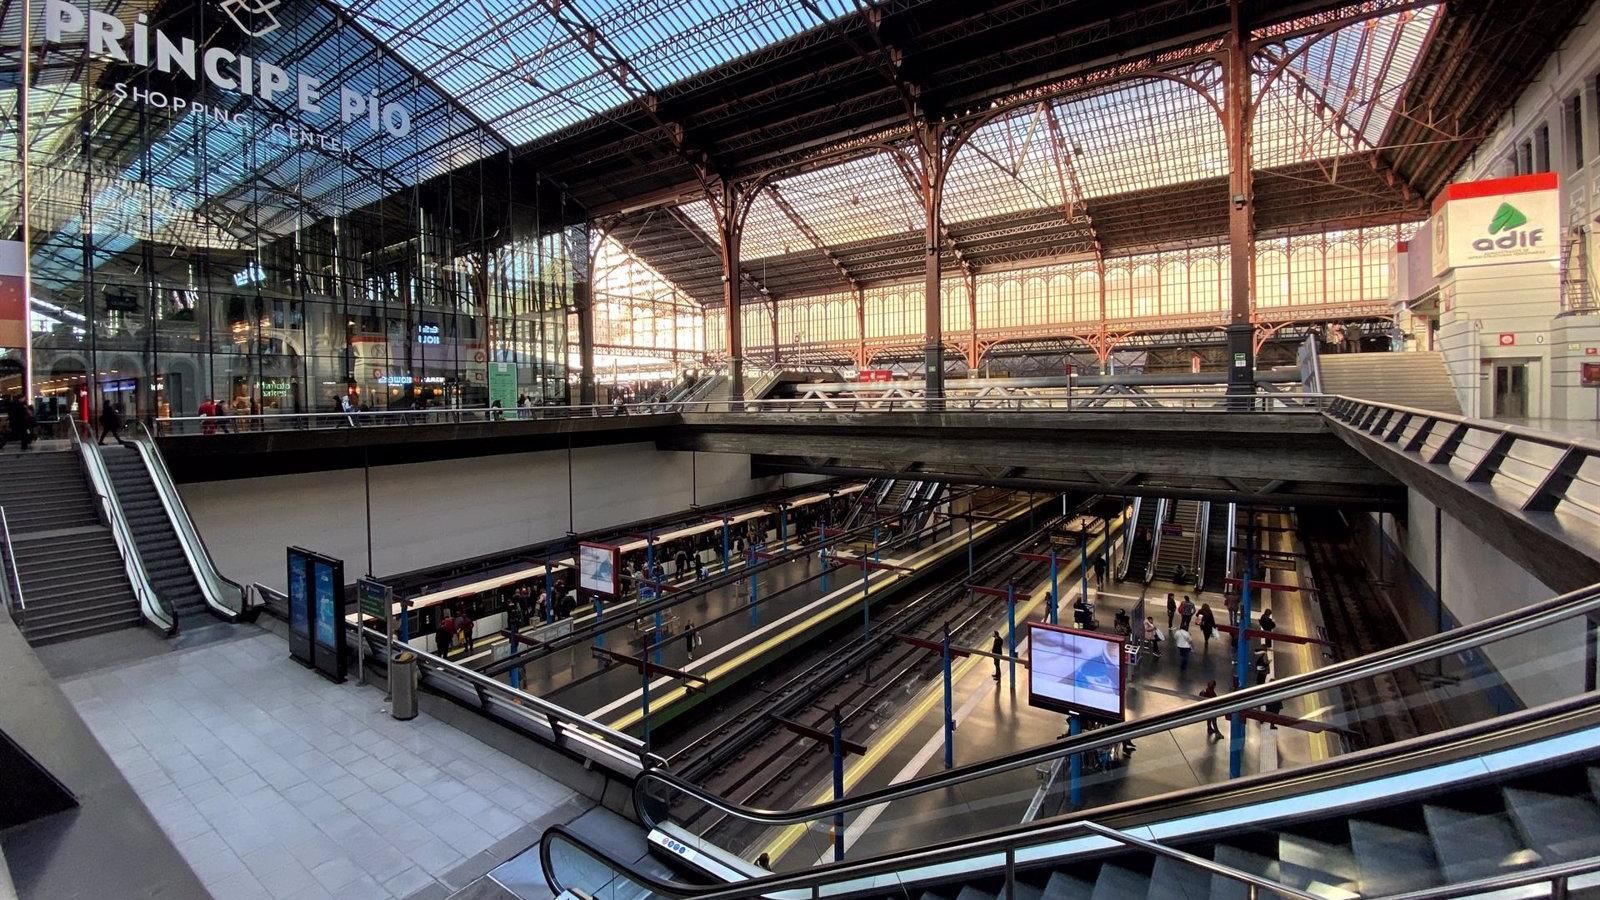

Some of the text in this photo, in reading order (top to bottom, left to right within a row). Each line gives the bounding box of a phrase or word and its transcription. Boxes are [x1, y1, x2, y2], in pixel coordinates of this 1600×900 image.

[113, 82, 352, 155] SHOPPING CENTER
[1472, 229, 1544, 251] adif
